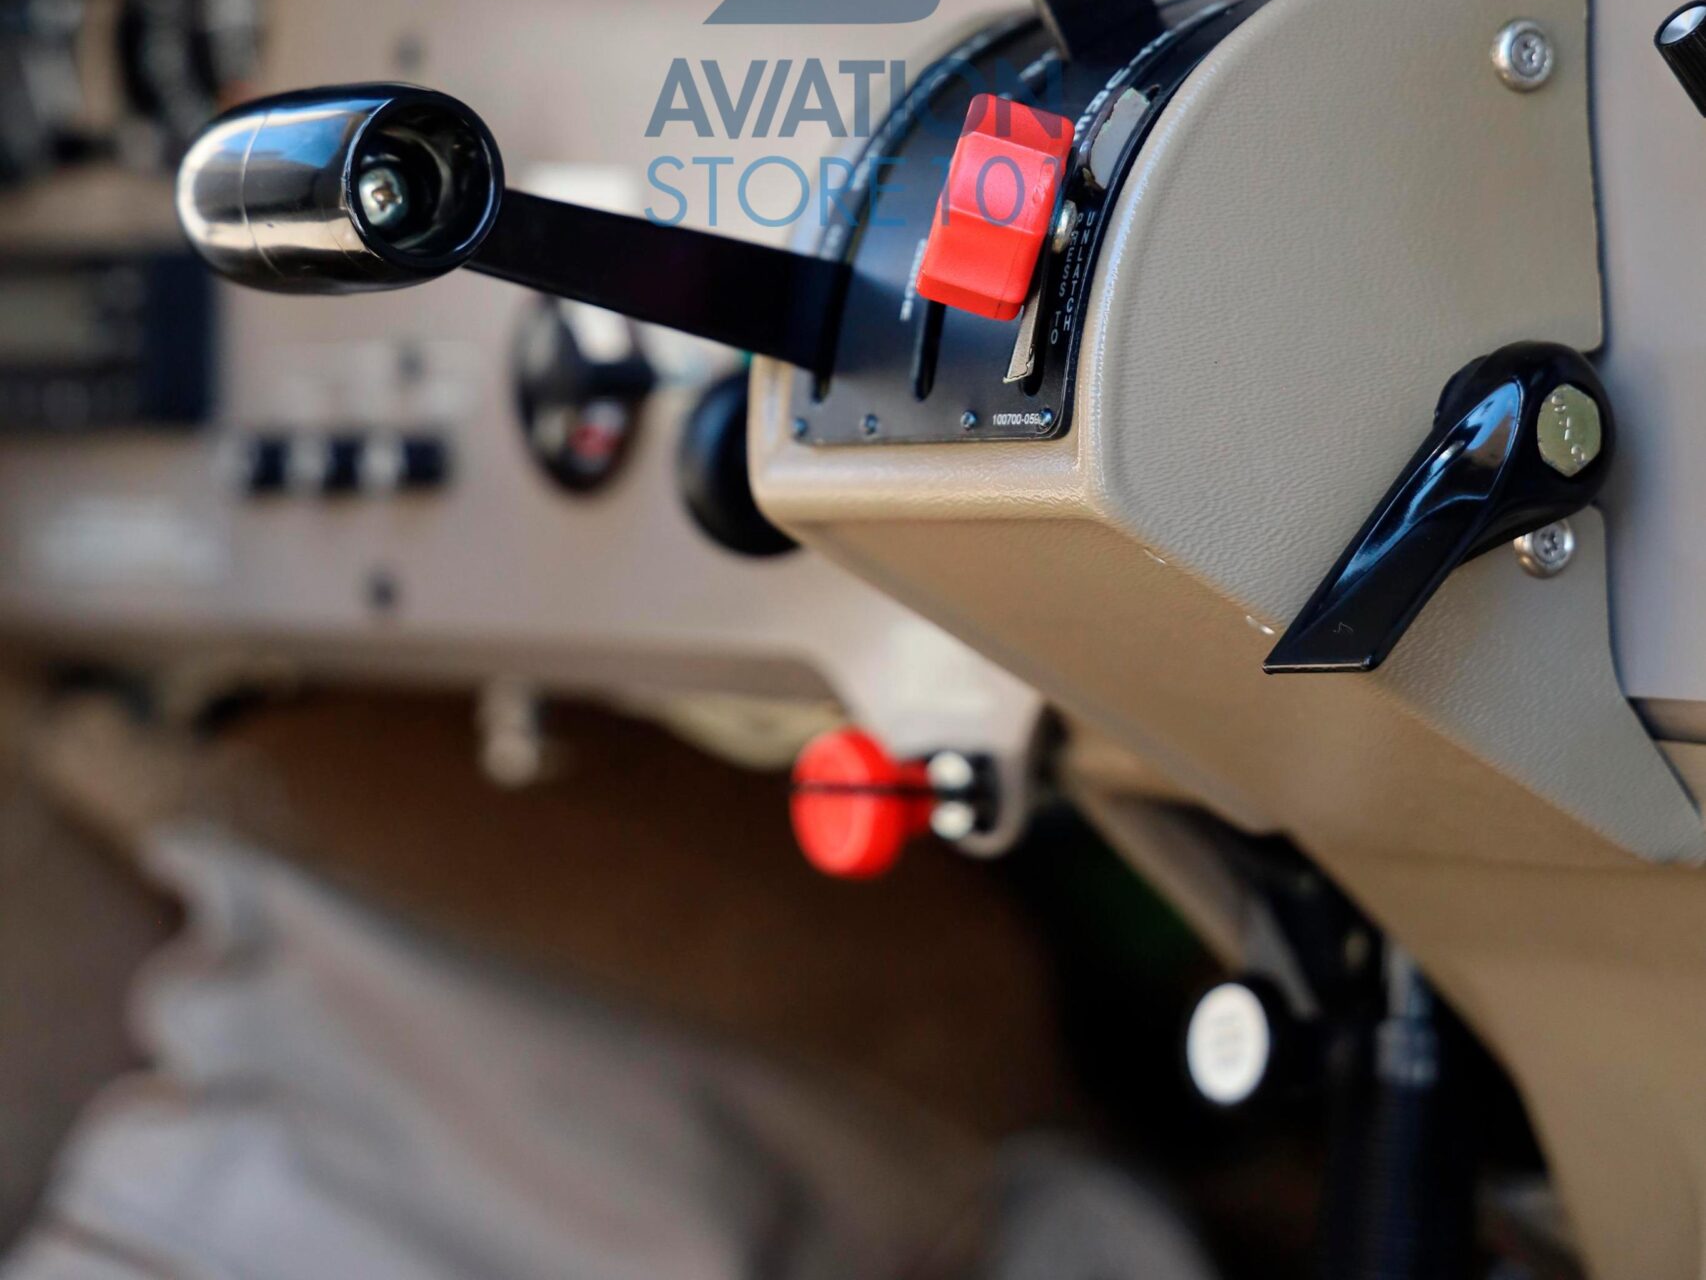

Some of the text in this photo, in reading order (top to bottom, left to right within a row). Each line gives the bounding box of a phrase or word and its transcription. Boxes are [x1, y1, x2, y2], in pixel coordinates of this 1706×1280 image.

[1050, 212, 1083, 345] PRESS TO
[1063, 210, 1096, 332] UNLATCH
